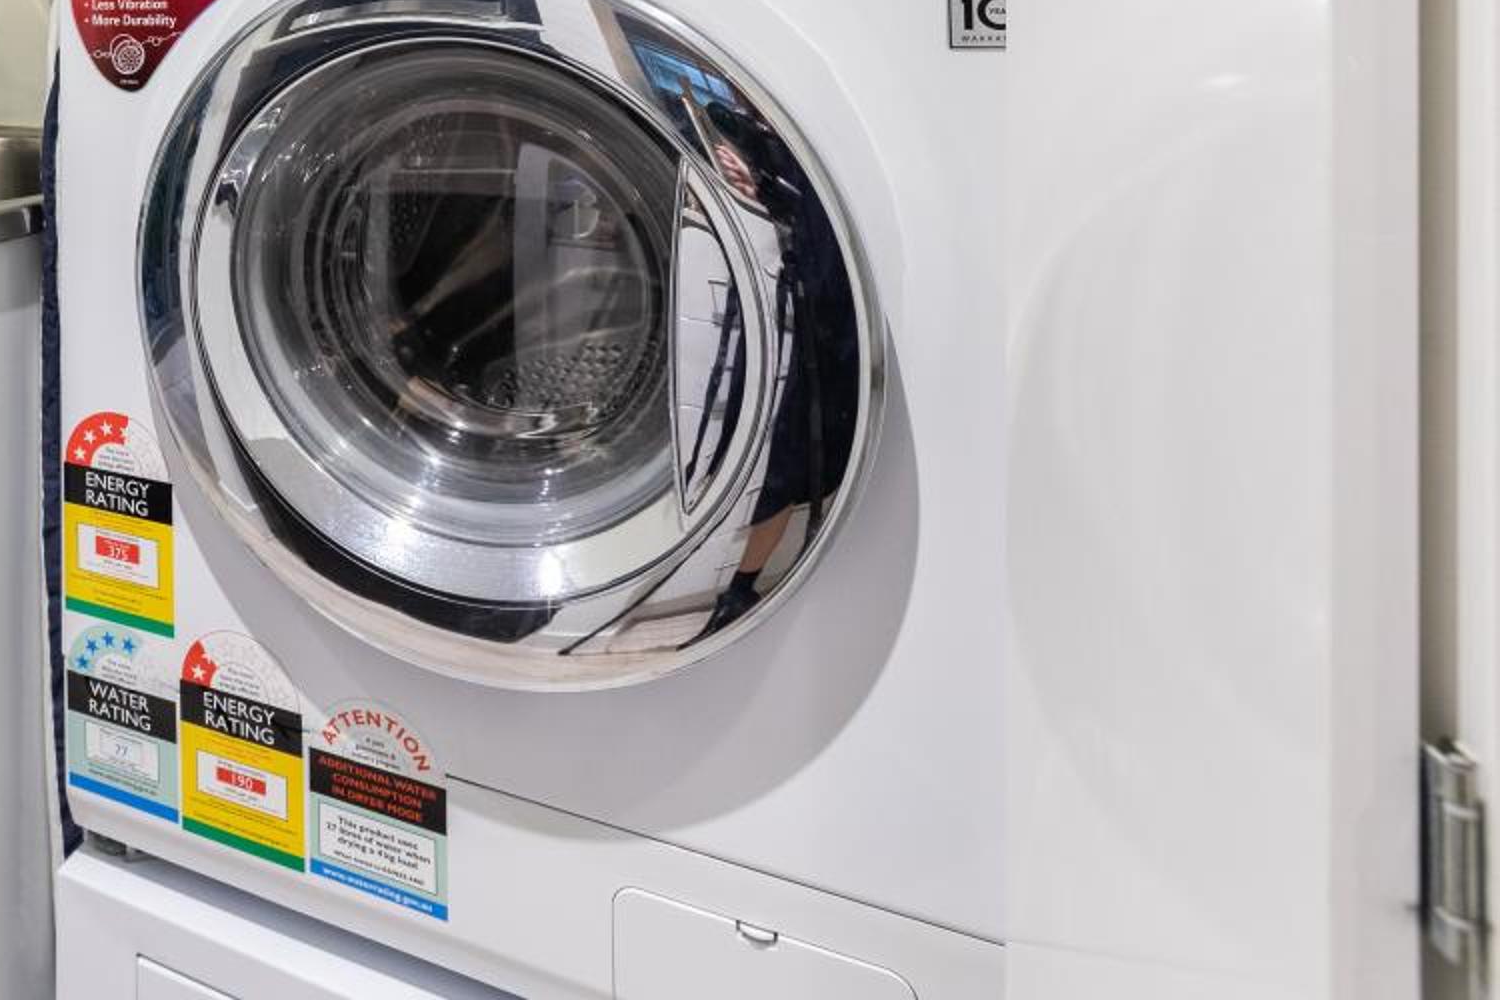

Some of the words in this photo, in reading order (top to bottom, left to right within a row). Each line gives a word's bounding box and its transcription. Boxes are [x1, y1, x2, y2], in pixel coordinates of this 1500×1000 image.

[91, 0, 115, 10] Less
[91, 15, 121, 26] More
[122, 14, 177, 29] Durability
[85, 471, 149, 498] ENERGY
[85, 489, 149, 516] RATING
[89, 680, 149, 713] WATER
[203, 691, 275, 726] ENERGY
[89, 698, 151, 731] RATING
[205, 709, 275, 745] RATING
[322, 709, 431, 772] ATTENTION
[231, 773, 253, 790] 190
[320, 756, 388, 784] ADDITIONAL
[393, 779, 437, 802] WATER
[332, 773, 422, 808] CONSUMPTION
